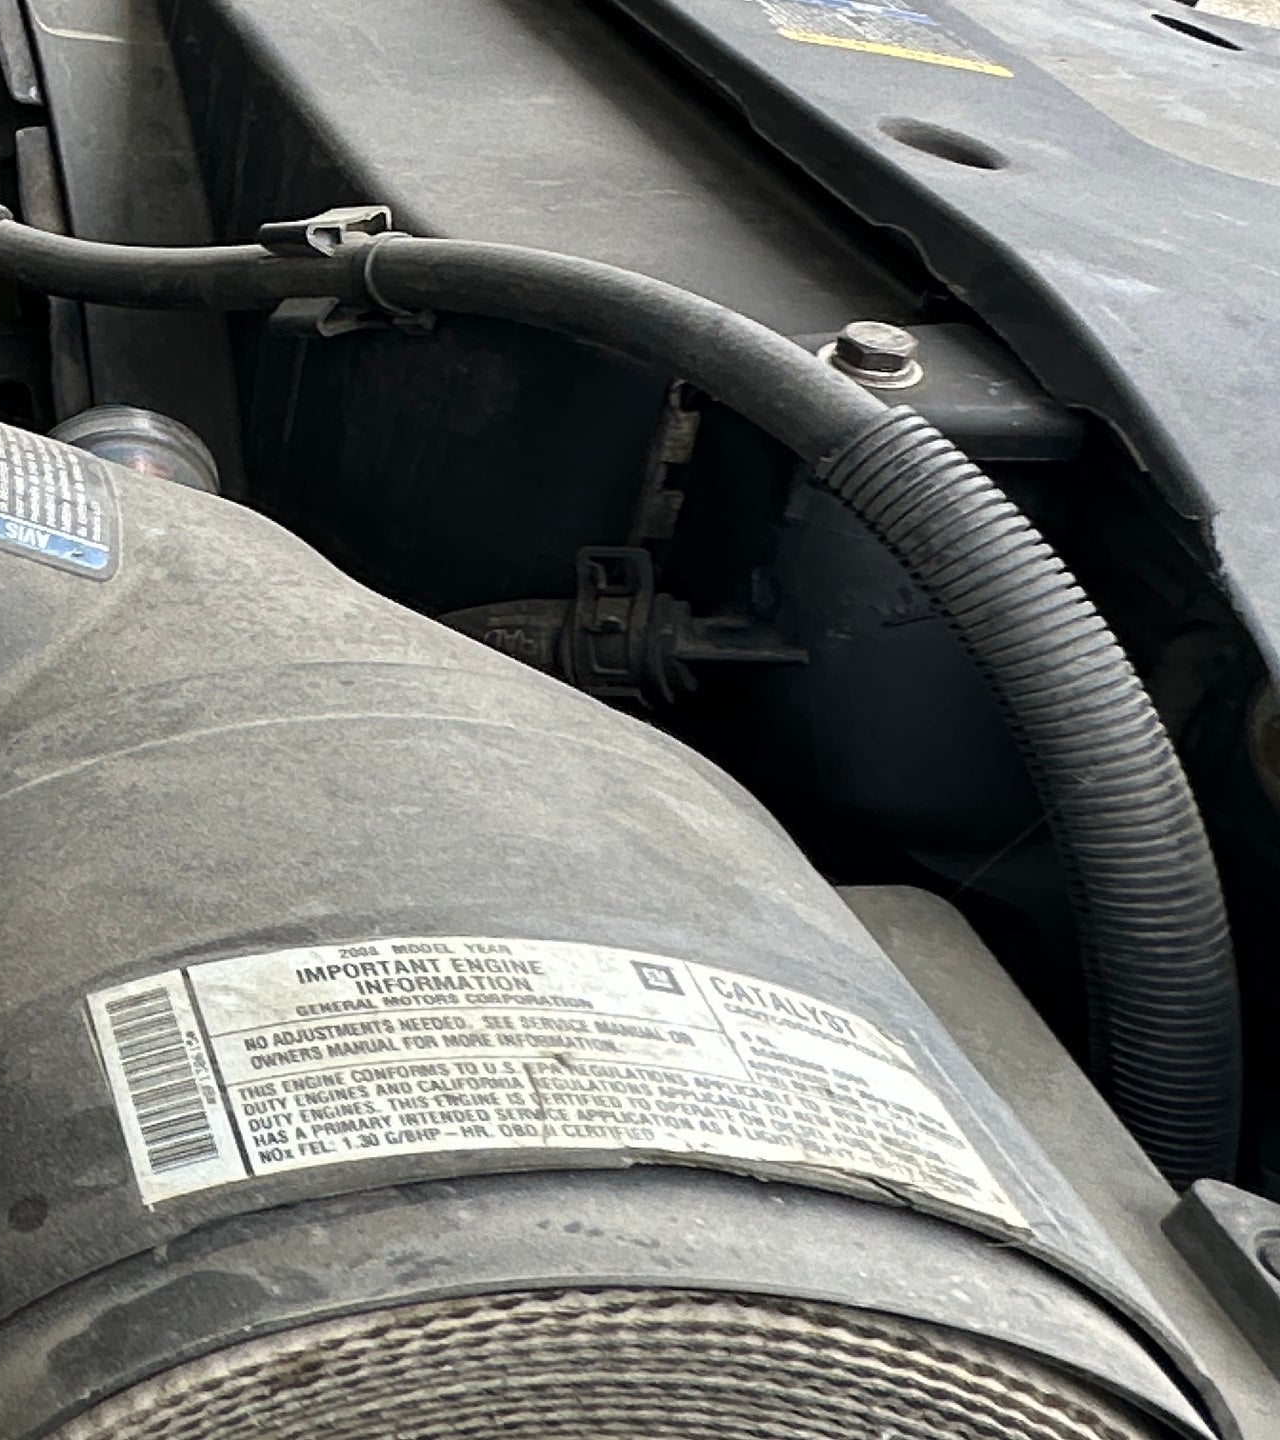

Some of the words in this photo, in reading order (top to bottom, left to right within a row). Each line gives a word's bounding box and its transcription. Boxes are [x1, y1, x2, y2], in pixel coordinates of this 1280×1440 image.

[5, 521, 52, 549] AVIS
[391, 943, 456, 954] MODEL
[463, 943, 513, 955] YEAR
[296, 958, 441, 984] IMPORTANT
[452, 957, 545, 977] ENGINE
[355, 976, 534, 996] INFORMATION
[296, 999, 379, 1017] GENERAL
[382, 994, 458, 1008] MOTORS
[465, 993, 594, 1010] CORPORATION
[710, 975, 858, 1039] CATALYST
[244, 1038, 268, 1051] NO
[272, 1019, 394, 1049] ADJUSTMENTS
[400, 1015, 474, 1032] NEEDED.
[482, 1016, 514, 1029] SEE
[520, 1016, 589, 1032] SERVICE
[594, 1020, 668, 1042] MANUAL
[668, 1030, 696, 1046] OR
[250, 1046, 323, 1070] OWNERS
[327, 1036, 400, 1058] MANUAL
[404, 1035, 442, 1050] FOR
[445, 1032, 495, 1048] MORE
[239, 1082, 278, 1102] THIS
[280, 1072, 346, 1094] ENGINE
[350, 1063, 450, 1083] CONFORMS
[454, 1063, 479, 1076] TO
[484, 1061, 522, 1075] U.S.
[243, 1097, 289, 1116] DUTY
[295, 1088, 370, 1108] ENGINES
[376, 1081, 413, 1095] AND
[418, 1076, 526, 1092] CALIFORNIA
[248, 1114, 294, 1132] DUTY
[388, 1096, 428, 1112] THIS
[434, 1092, 501, 1107] ENGINE
[506, 1091, 527, 1105] IS
[628, 1096, 652, 1111] TO
[654, 1099, 736, 1122] OPERATE
[252, 1129, 290, 1148] HAS
[295, 1126, 308, 1140] A
[311, 1116, 392, 1137] PRIMARY
[399, 1109, 490, 1126] INTENDED
[497, 1109, 570, 1122] SERVICE
[576, 1109, 694, 1130] APPLICATION
[699, 1120, 723, 1136] AS
[259, 1146, 295, 1164] NOx
[384, 1128, 442, 1146] G/BHP
[499, 1124, 539, 1138] OBD
[561, 1124, 656, 1141] CERTIFIED
